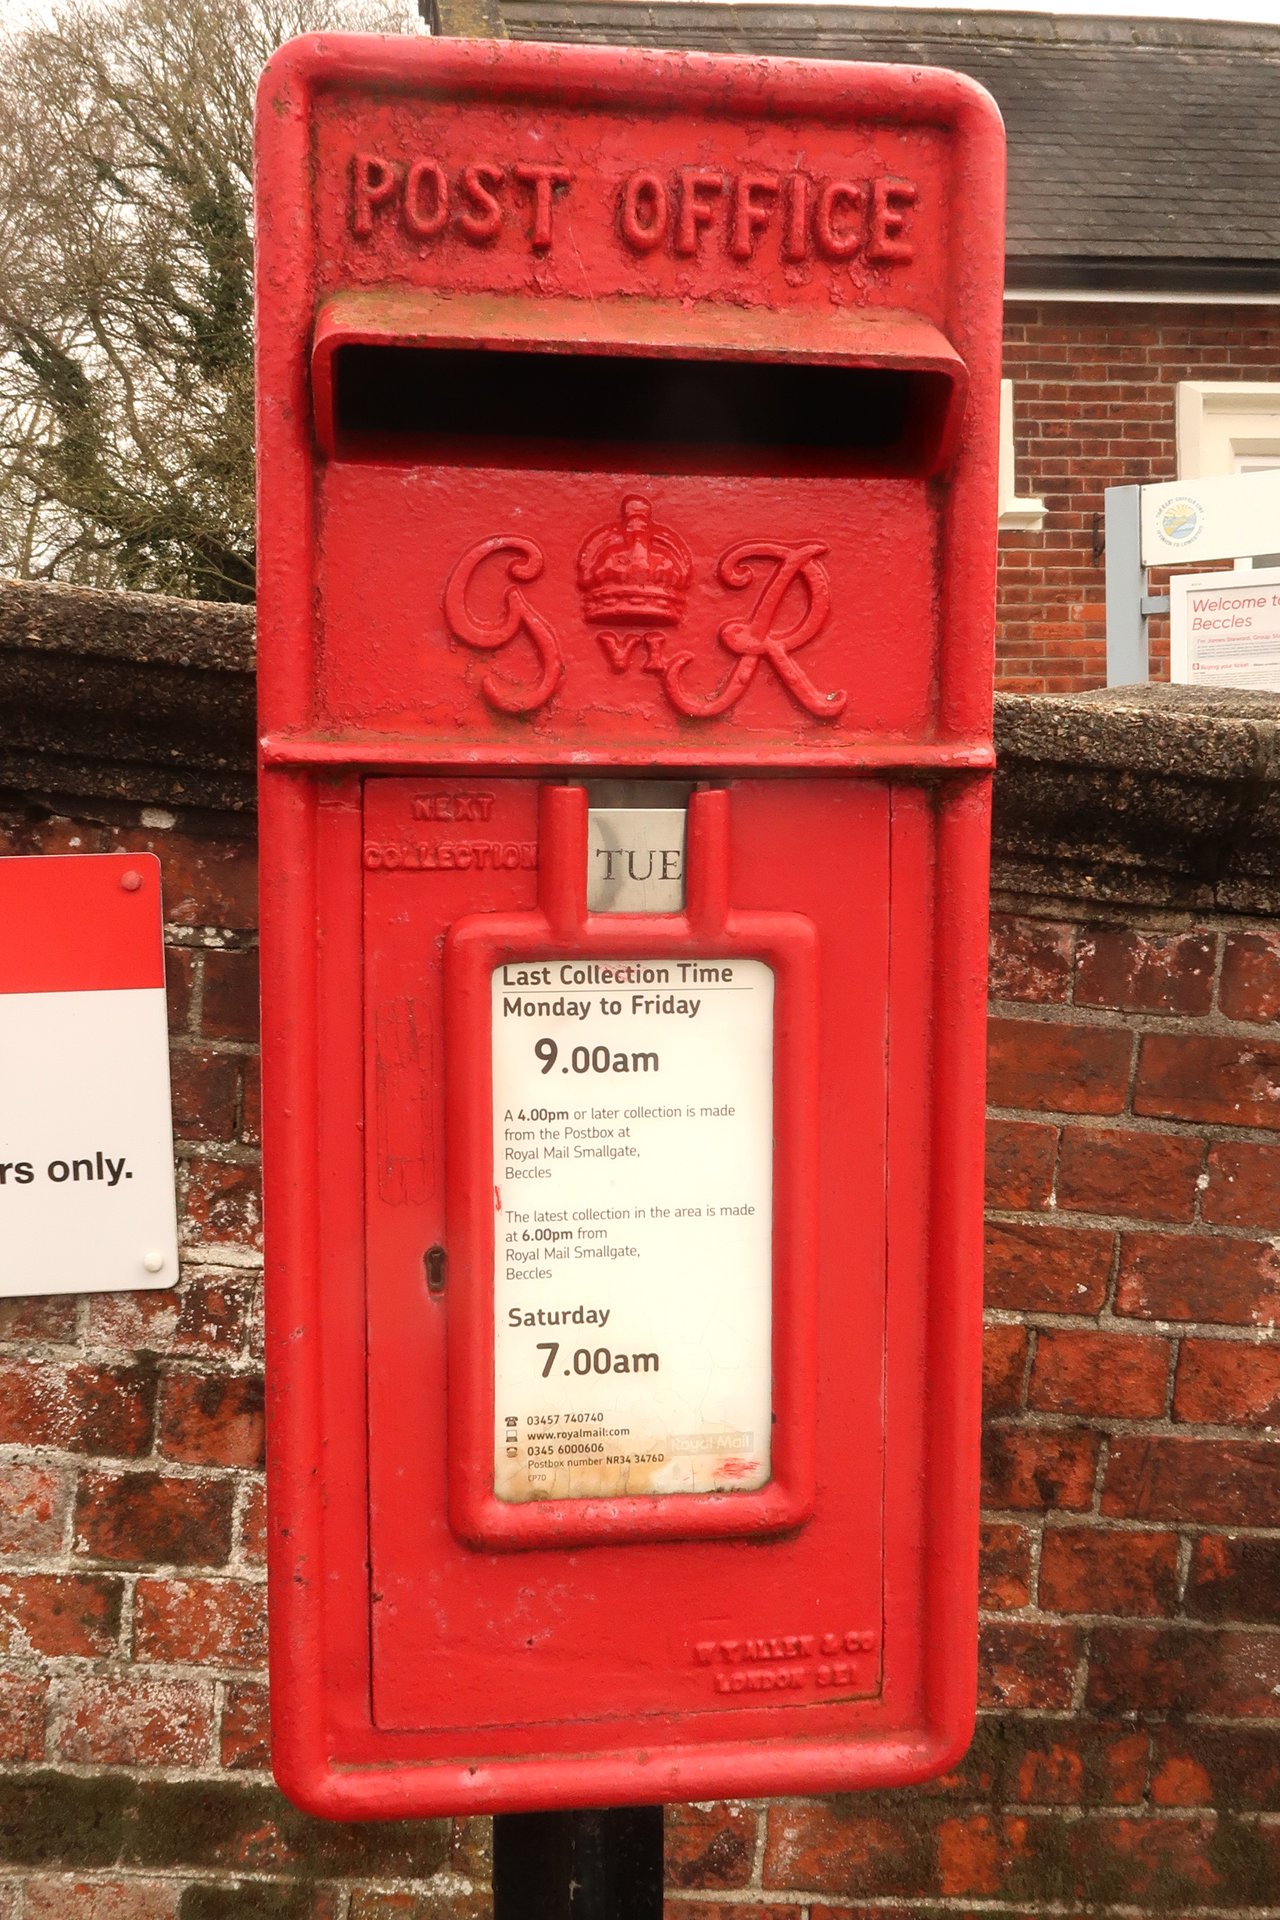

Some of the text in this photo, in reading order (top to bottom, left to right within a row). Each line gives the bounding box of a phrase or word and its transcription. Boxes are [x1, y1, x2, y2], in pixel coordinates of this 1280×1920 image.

[349, 152, 920, 265] POST OFFICE
[1192, 595, 1280, 613] Welcome t
[1192, 615, 1253, 631] Beccles
[411, 793, 496, 822] NEXT
[363, 840, 539, 871] COLLECTION
[596, 848, 685, 880] TUE
[503, 963, 733, 986] Last Collection Time
[504, 995, 701, 1020] Monday to Friday
[535, 1038, 659, 1074] 9.00am
[504, 1104, 735, 1123] A 4.00pm or later collection is made
[505, 1127, 630, 1141] from the Postbox at
[506, 1145, 640, 1162] Royal Mail Smallgate,
[48, 1152, 132, 1186] only.
[506, 1166, 551, 1179] Beccles
[505, 1204, 755, 1223] The latest collection in the area is made
[506, 1228, 607, 1243] at 6.00pm from
[506, 1246, 640, 1263] Royal Mail Smallgate,
[507, 1267, 552, 1280] Beccles
[509, 1305, 610, 1327] Saturday
[536, 1342, 659, 1378] 7.00am
[527, 1413, 603, 1425] 03457 740740
[528, 1443, 604, 1456] 0345 6000606
[672, 1435, 750, 1452] Royal Mail
[528, 1459, 565, 1469] Postbox
[567, 1457, 603, 1466] number
[606, 1456, 631, 1464] NR34
